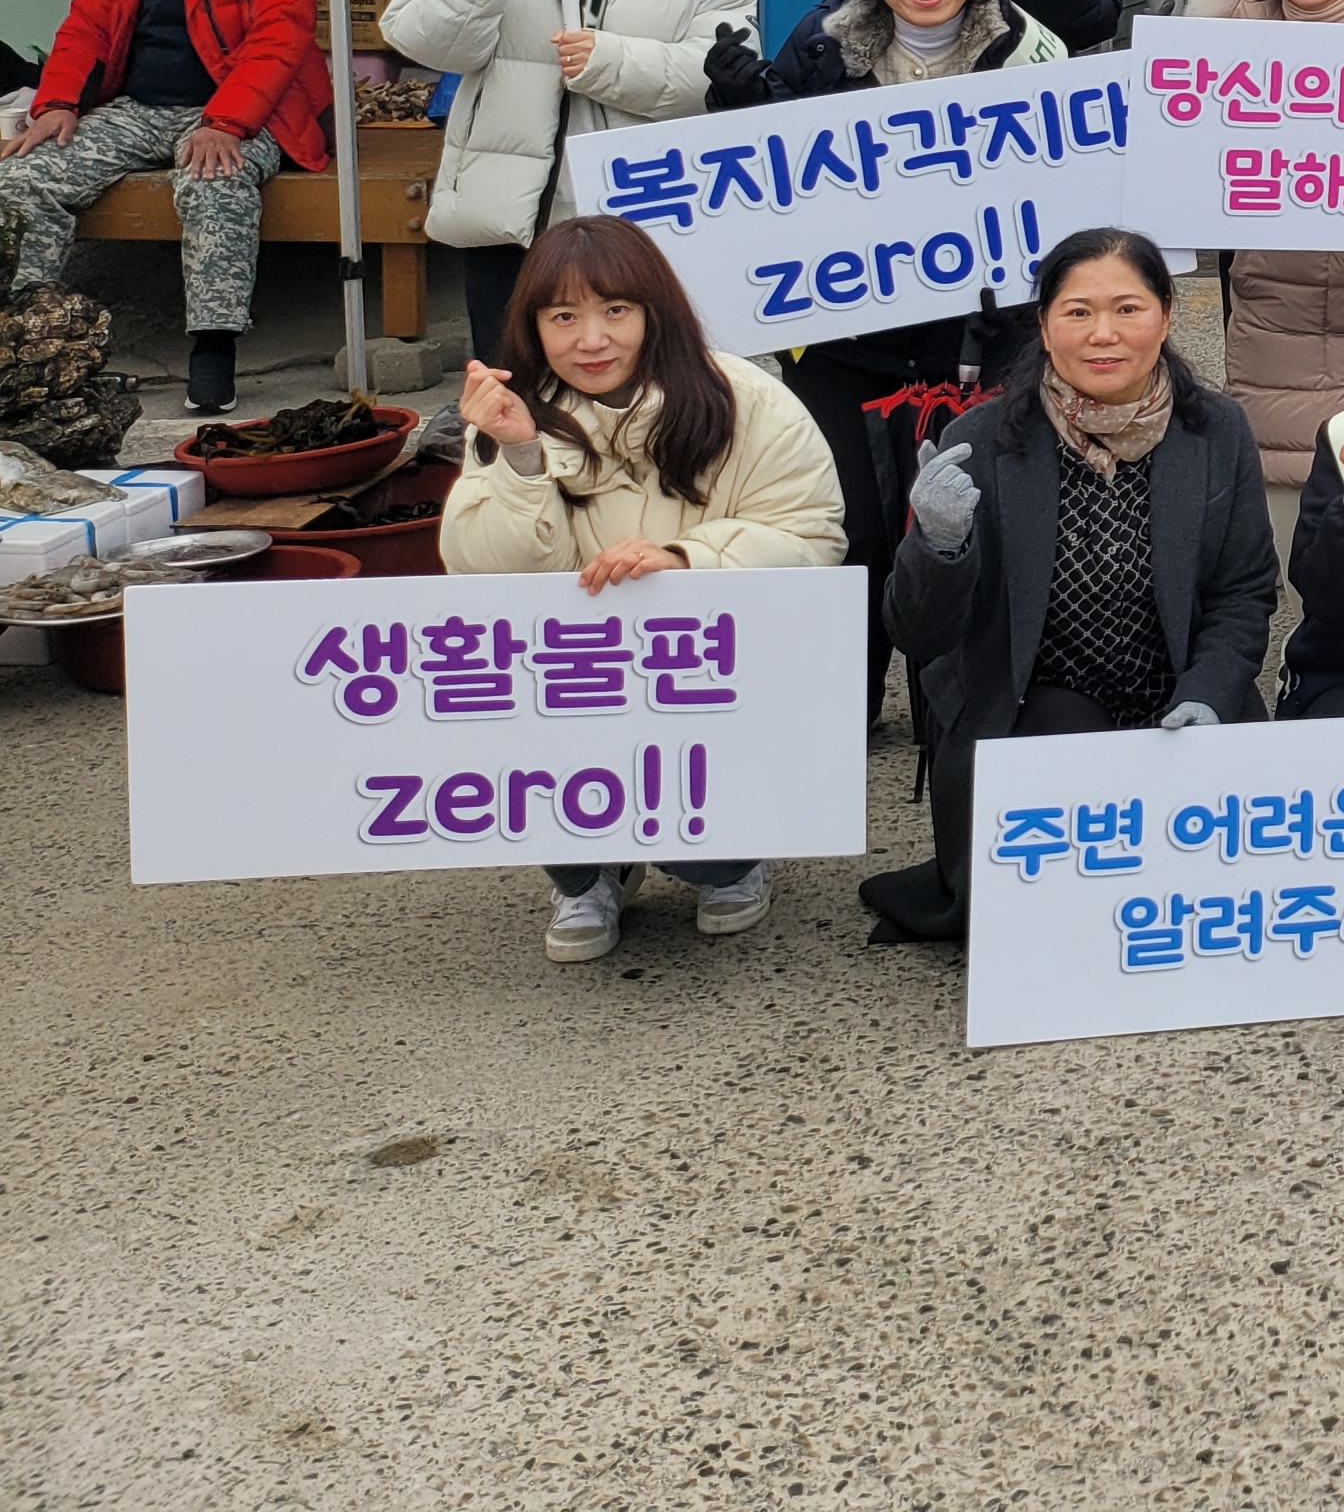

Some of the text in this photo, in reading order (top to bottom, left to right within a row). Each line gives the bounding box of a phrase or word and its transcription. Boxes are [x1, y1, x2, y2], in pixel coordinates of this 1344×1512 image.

[754, 198, 1042, 318] zero!!
[304, 612, 739, 719] 생활불편
[364, 742, 708, 839] zero!!
[996, 797, 1145, 878] 주변
